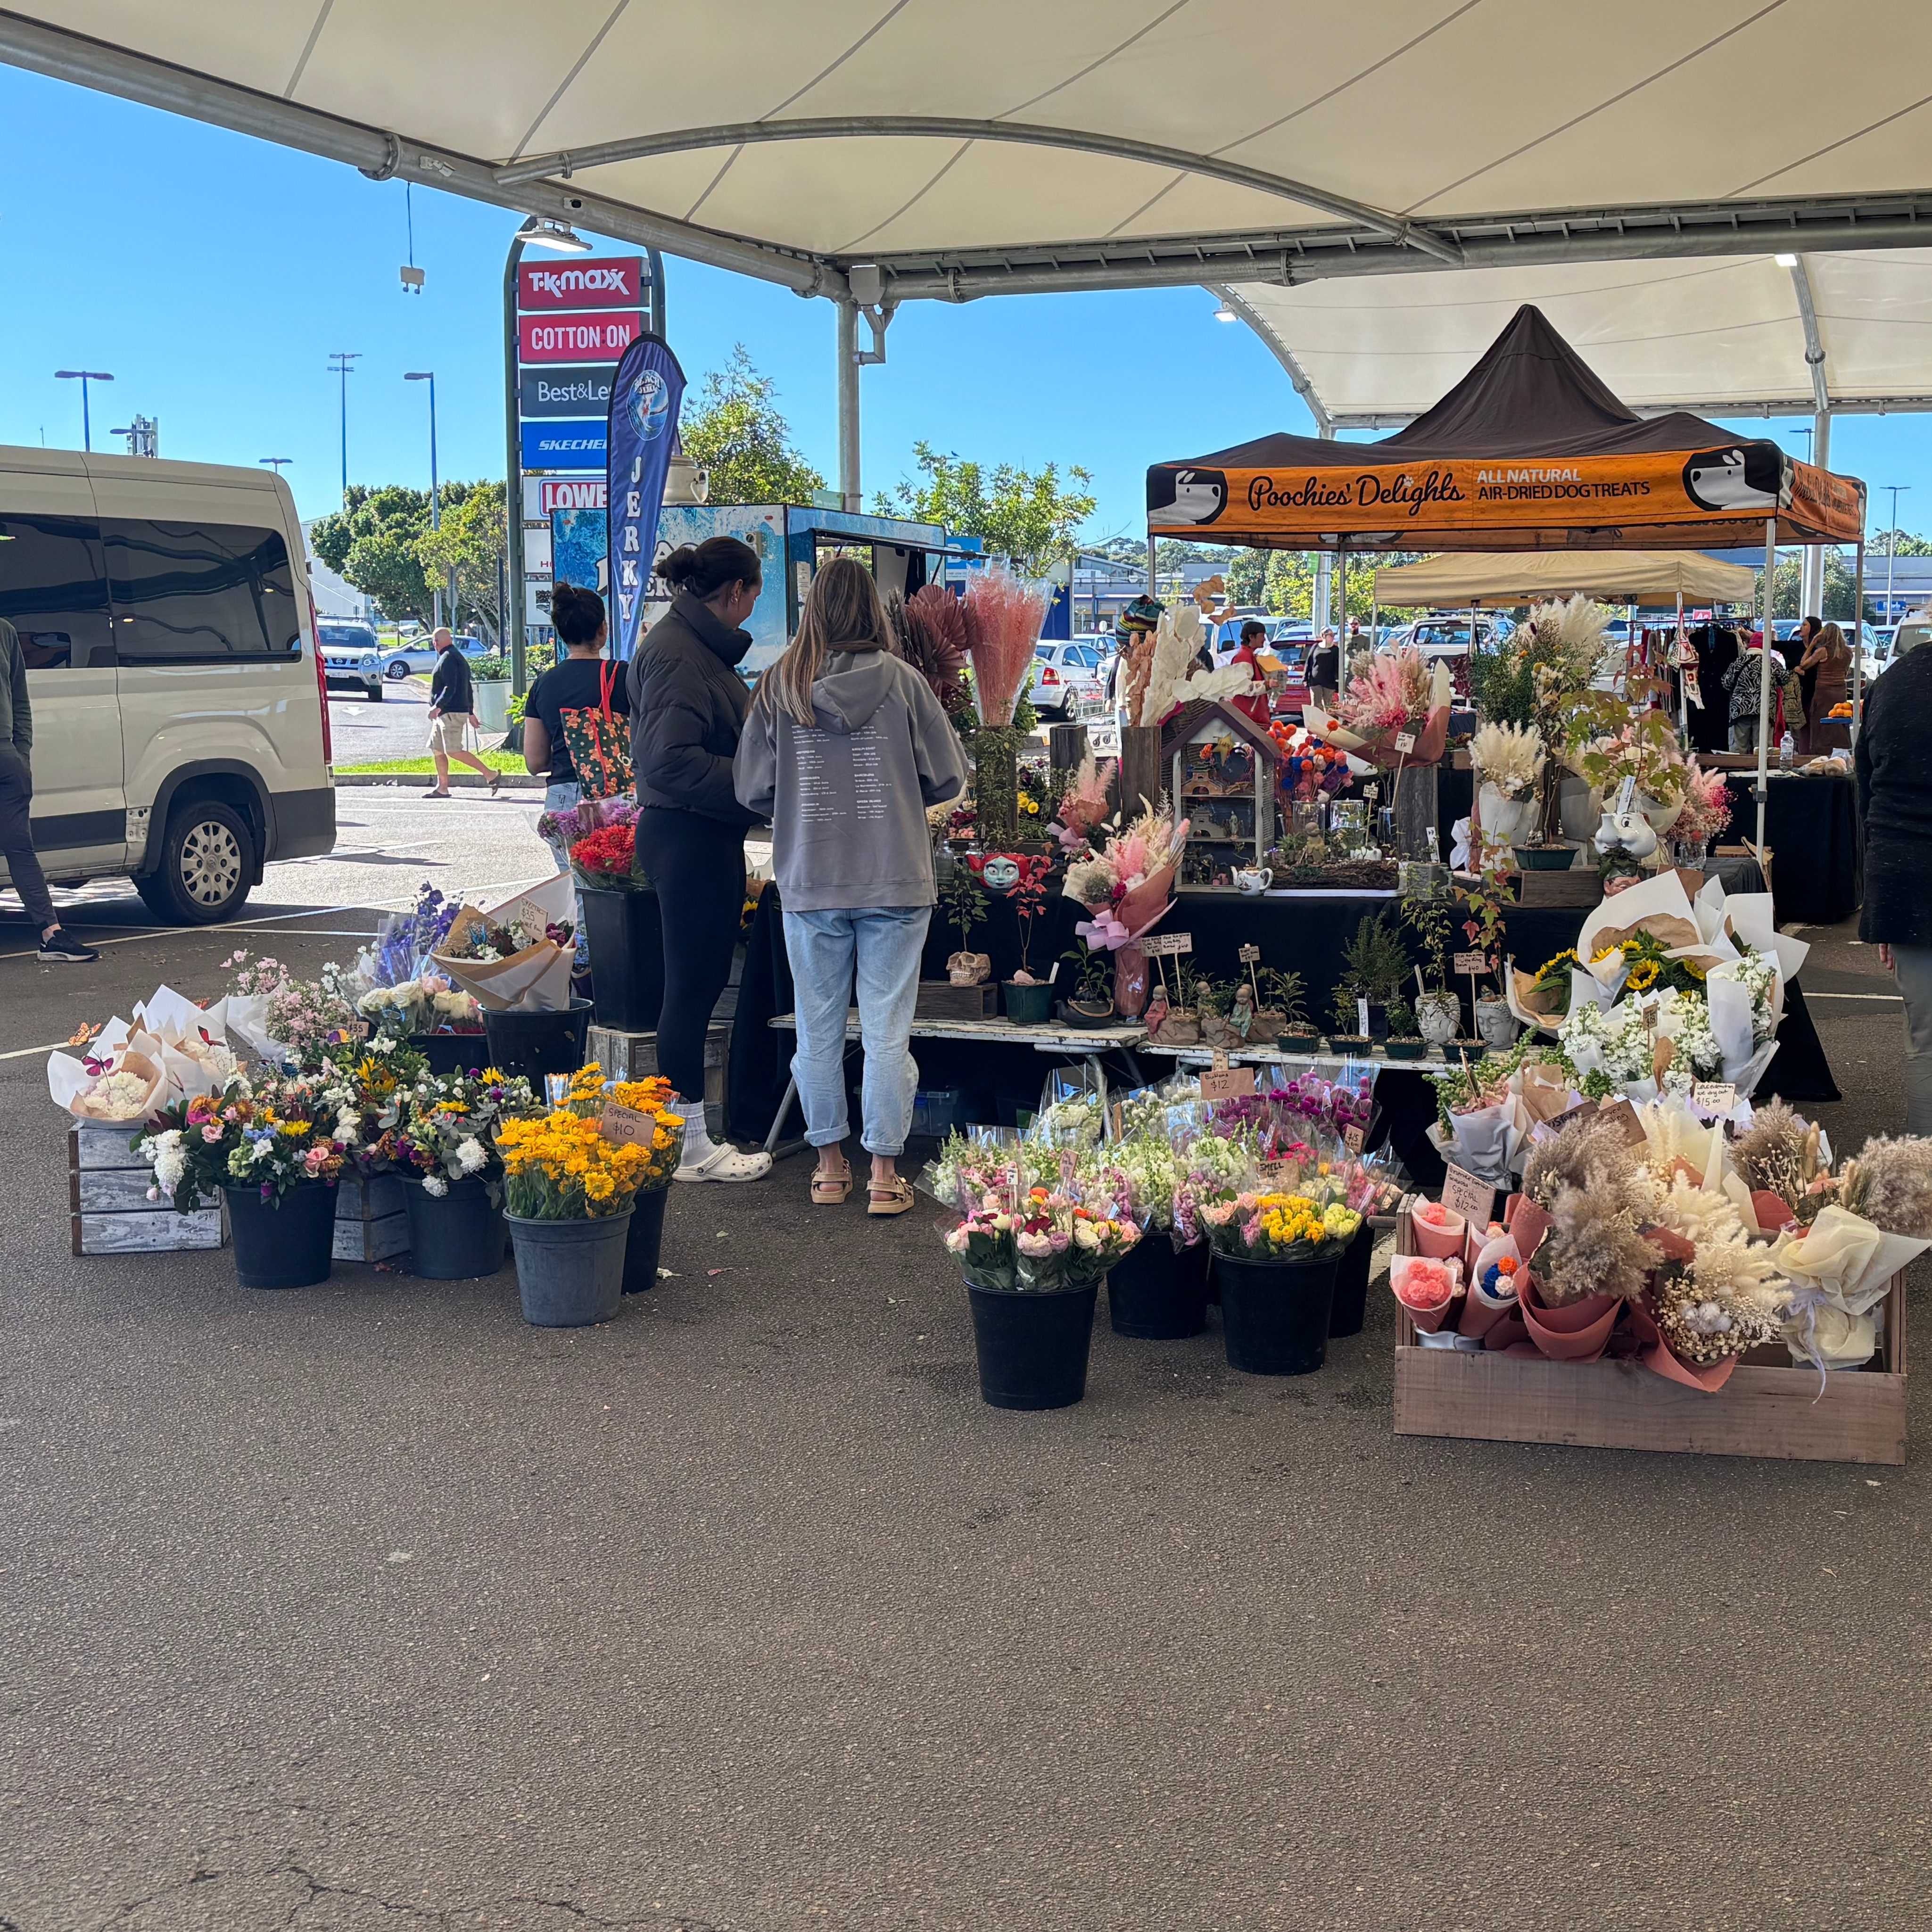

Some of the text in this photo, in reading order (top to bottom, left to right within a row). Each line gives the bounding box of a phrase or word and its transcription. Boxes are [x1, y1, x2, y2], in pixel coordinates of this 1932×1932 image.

[538, 380, 611, 402] Best&Le
[1477, 468, 1582, 484] ALL NATURAL
[1356, 471, 1465, 516] Delights
[1478, 481, 1651, 501] AIR-DRIED DOG TREATS
[521, 907, 535, 921] $35
[349, 1024, 363, 1032] $35
[1211, 1080, 1230, 1092] $12
[1696, 1096, 1720, 1107] $15.00
[609, 1107, 641, 1123] SPECIAL
[613, 1121, 635, 1136] $10
[1452, 1184, 1478, 1203] SPECIAL
